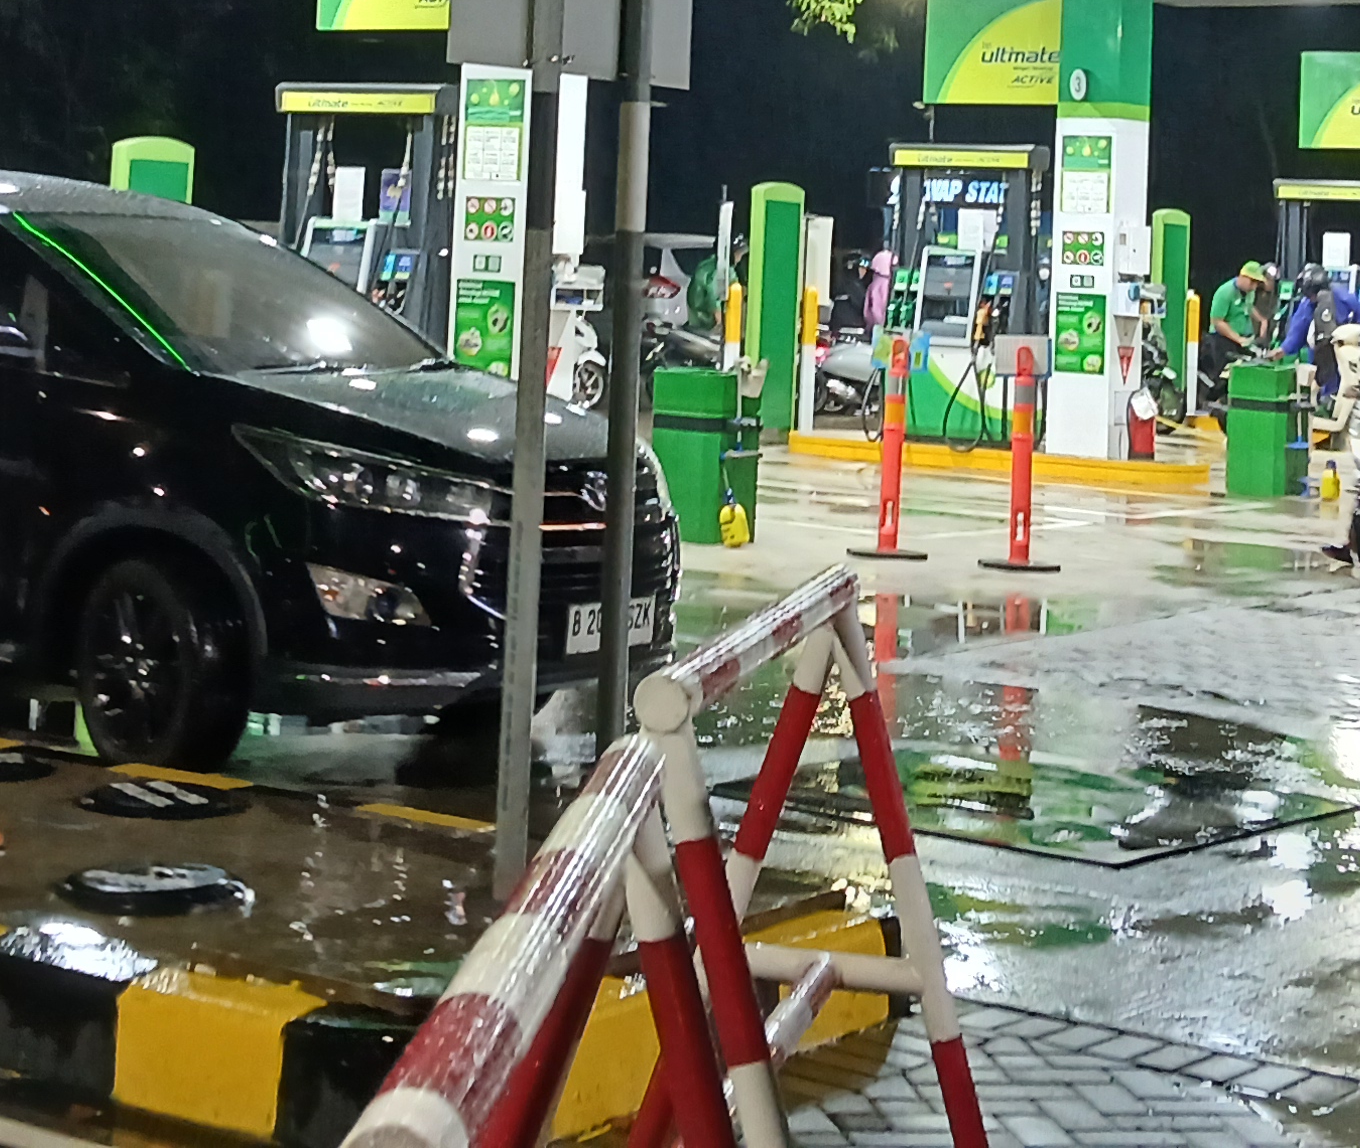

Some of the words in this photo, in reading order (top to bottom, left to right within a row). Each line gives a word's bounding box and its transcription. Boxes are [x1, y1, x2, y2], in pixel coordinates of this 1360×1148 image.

[981, 46, 1060, 63] ultimate
[1011, 75, 1054, 85] ACTIVE
[1074, 76, 1082, 93] 3
[924, 178, 963, 203] WAP
[964, 180, 1009, 204] STAT
[572, 611, 581, 637] B
